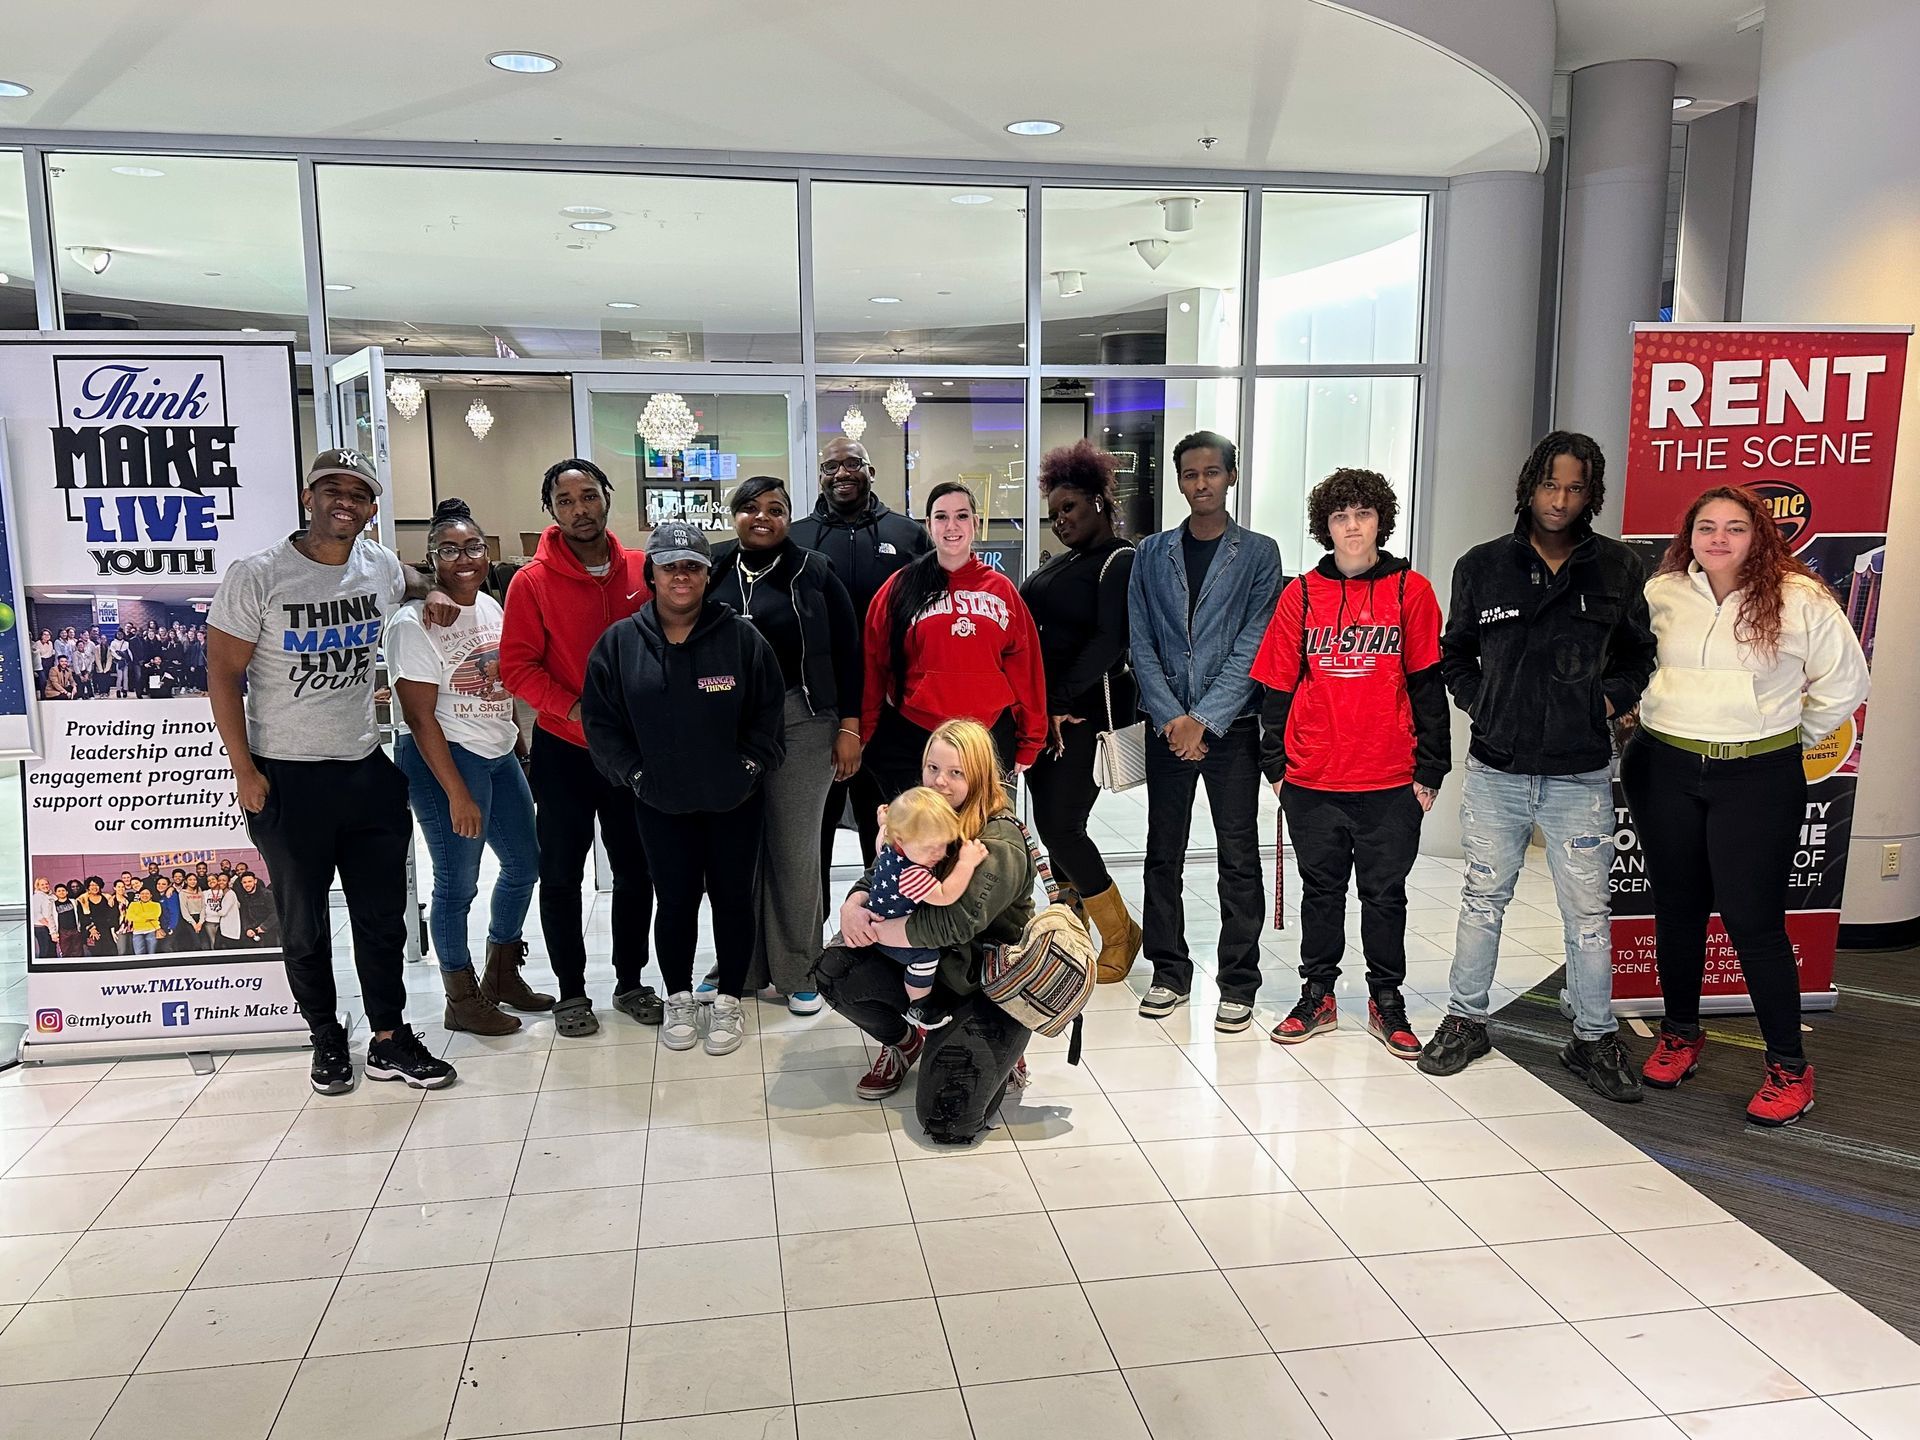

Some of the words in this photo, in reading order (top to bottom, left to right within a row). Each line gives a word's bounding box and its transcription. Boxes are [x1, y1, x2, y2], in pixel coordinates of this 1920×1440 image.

[73, 364, 210, 420] Think
[1649, 355, 1887, 429] RENT
[48, 424, 243, 496] MAKE
[1651, 437, 1729, 472] THE
[1742, 432, 1874, 469] SCENE
[83, 495, 219, 543] LIVE
[711, 501, 732, 516] Sce
[674, 537, 689, 547] MOM
[87, 547, 217, 576] YOUTH
[282, 592, 382, 629] THINK
[954, 589, 1010, 632] STATE
[283, 620, 381, 653] MAKE
[1339, 624, 1402, 655] STAR
[300, 646, 370, 673] LIVE
[1318, 656, 1377, 667] ELITE
[697, 675, 737, 690] STRANGER
[705, 683, 732, 693] THINGS
[65, 720, 156, 740] Providing
[161, 718, 216, 735] innov
[70, 742, 168, 763] leadership
[174, 741, 213, 757] and
[1806, 751, 1838, 760] GUESTS!
[29, 768, 143, 789] engagement
[148, 766, 235, 787] program
[32, 794, 104, 812] support
[107, 788, 224, 812] opportunity
[94, 817, 126, 832] our
[130, 811, 245, 831] community.
[141, 850, 216, 868] WELCOME
[1609, 855, 1645, 873] AN
[1793, 849, 1826, 869] OF
[1608, 878, 1652, 893] SCEN
[1788, 872, 1823, 887] ELF!
[1634, 935, 1657, 946] VISI
[1617, 950, 1634, 960] TO
[1637, 949, 1658, 959] TAL
[1611, 963, 1651, 974] SCENE
[100, 976, 264, 997] www.TMLYouth.org
[65, 1010, 153, 1029] @tmlyouth
[194, 1004, 240, 1021] Think
[243, 1003, 289, 1018] Make
